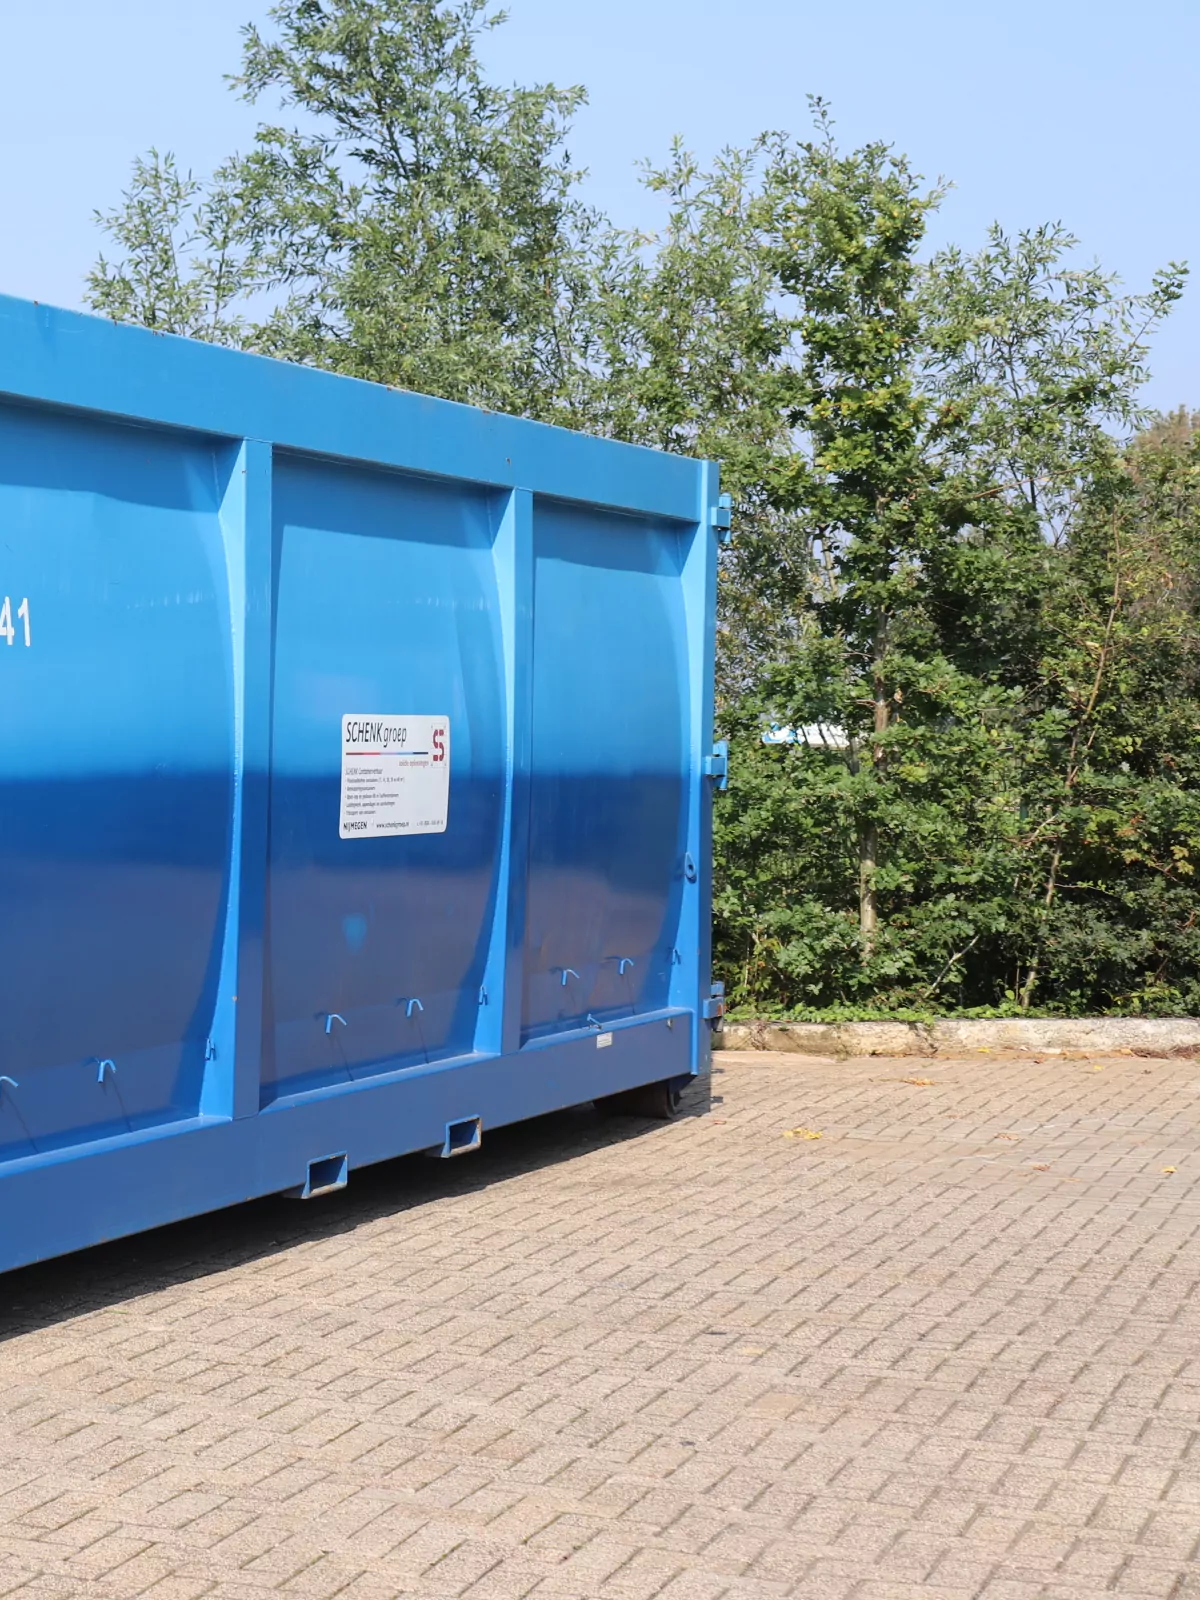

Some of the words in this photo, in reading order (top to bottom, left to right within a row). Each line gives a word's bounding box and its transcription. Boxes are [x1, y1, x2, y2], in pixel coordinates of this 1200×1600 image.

[345, 722, 383, 743] SCHENK
[383, 727, 407, 748] groep
[343, 821, 368, 832] NIJMEGEN
